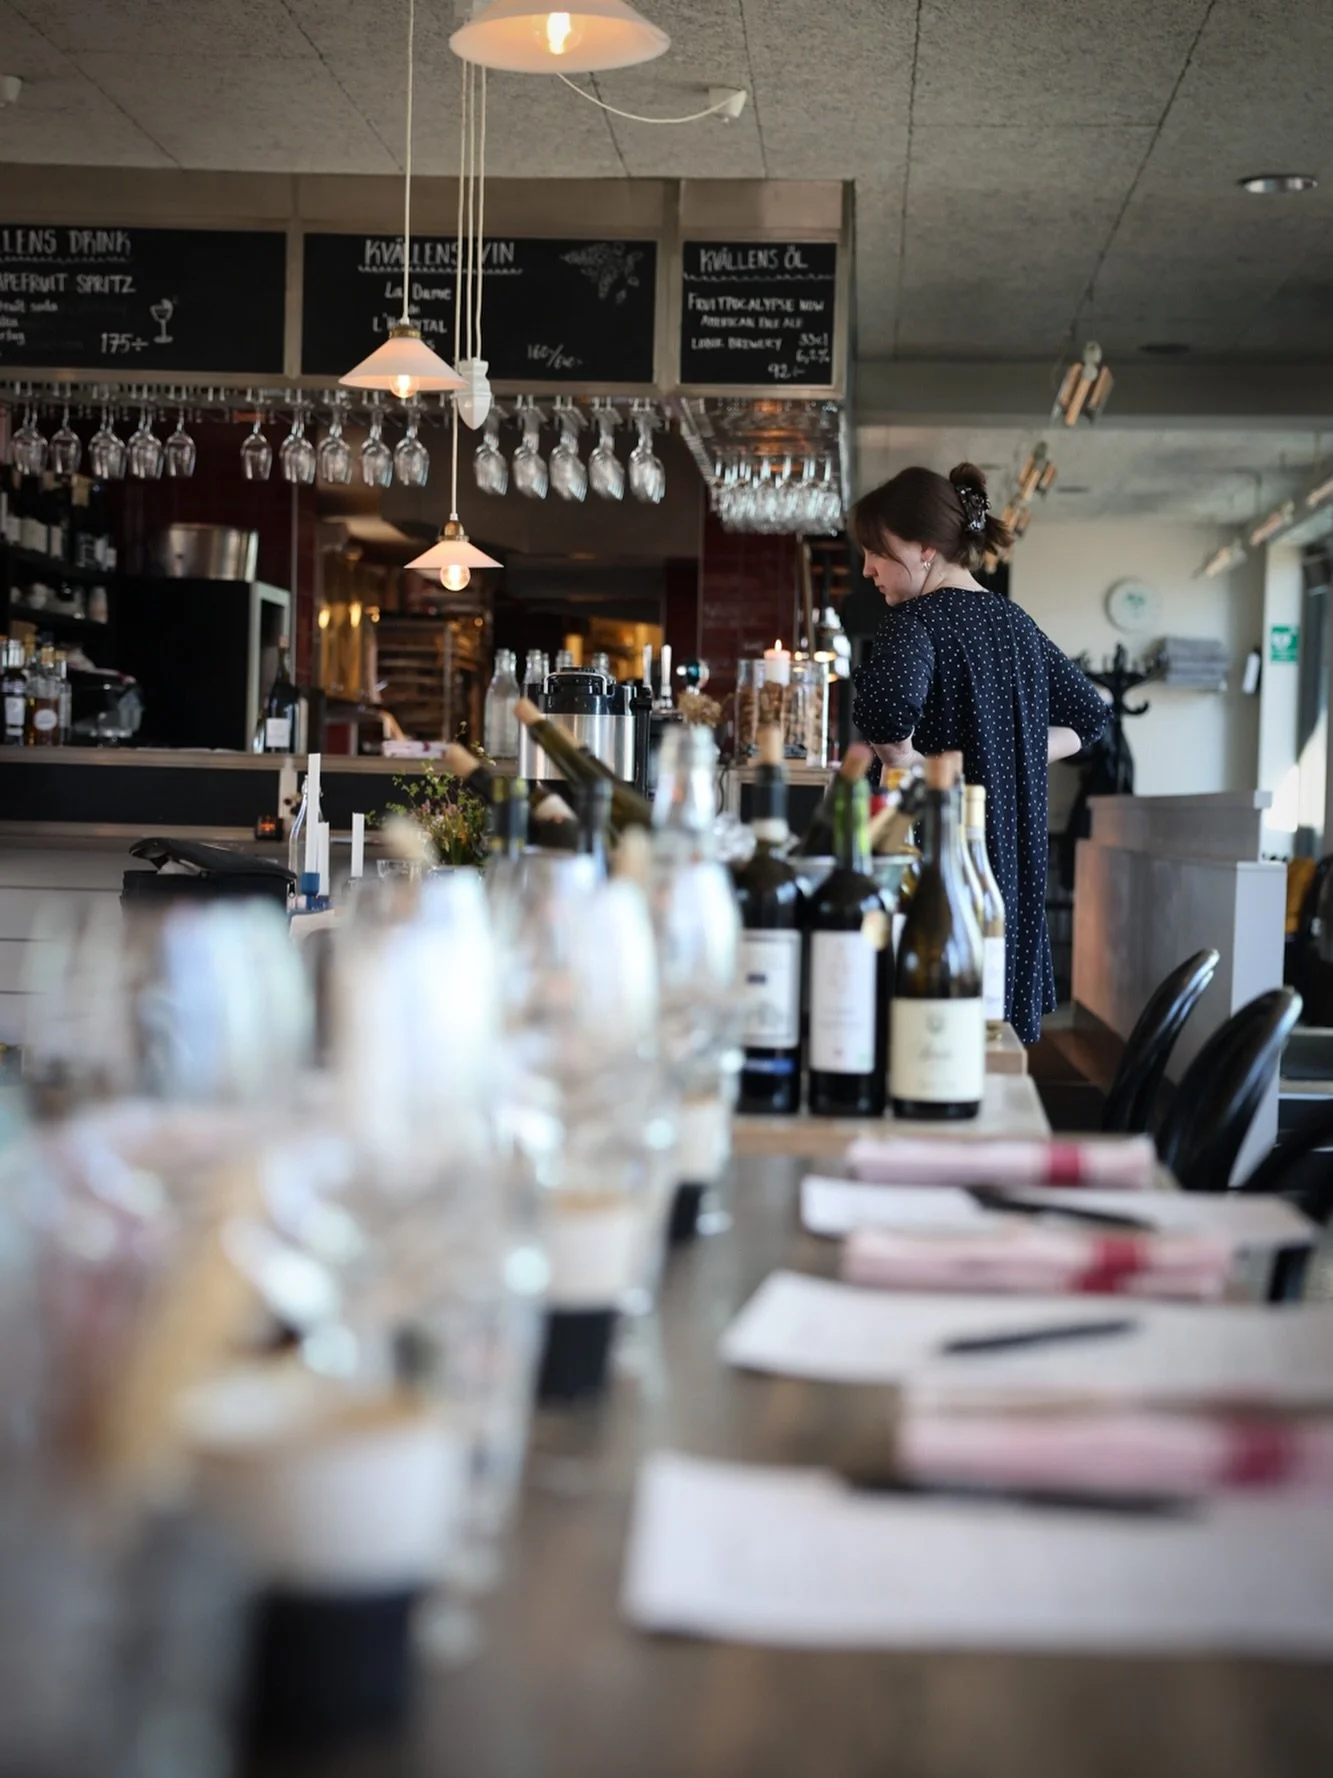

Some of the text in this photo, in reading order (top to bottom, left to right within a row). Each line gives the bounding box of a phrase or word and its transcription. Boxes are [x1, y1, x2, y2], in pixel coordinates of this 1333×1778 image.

[364, 236, 460, 266] KVÄLENS
[700, 245, 808, 272] KVÄLLENS ÖL
[76, 274, 136, 294] SPRITZ
[799, 299, 825, 311] NOW
[782, 317, 803, 328] ALE
[728, 337, 783, 351] BREWERY
